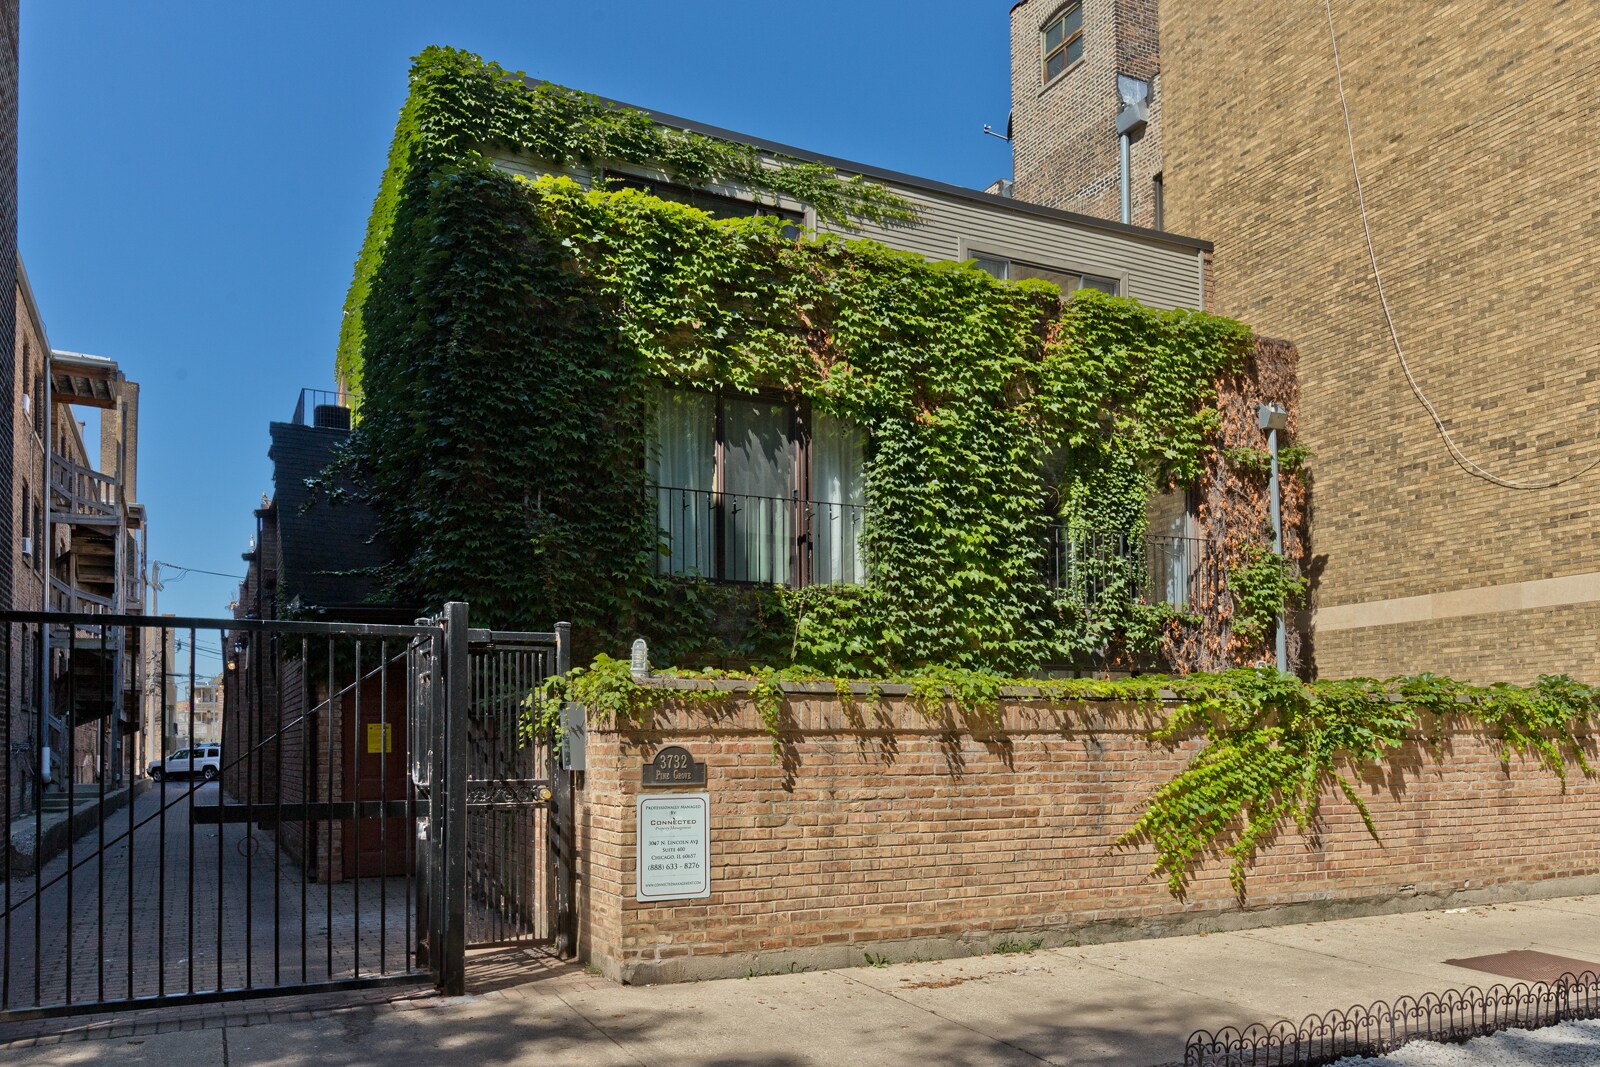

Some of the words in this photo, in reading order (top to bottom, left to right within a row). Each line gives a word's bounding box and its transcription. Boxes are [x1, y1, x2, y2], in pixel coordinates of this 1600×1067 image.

[660, 754, 687, 769] 3732
[656, 770, 670, 780] PINE
[673, 770, 692, 780] GROVE
